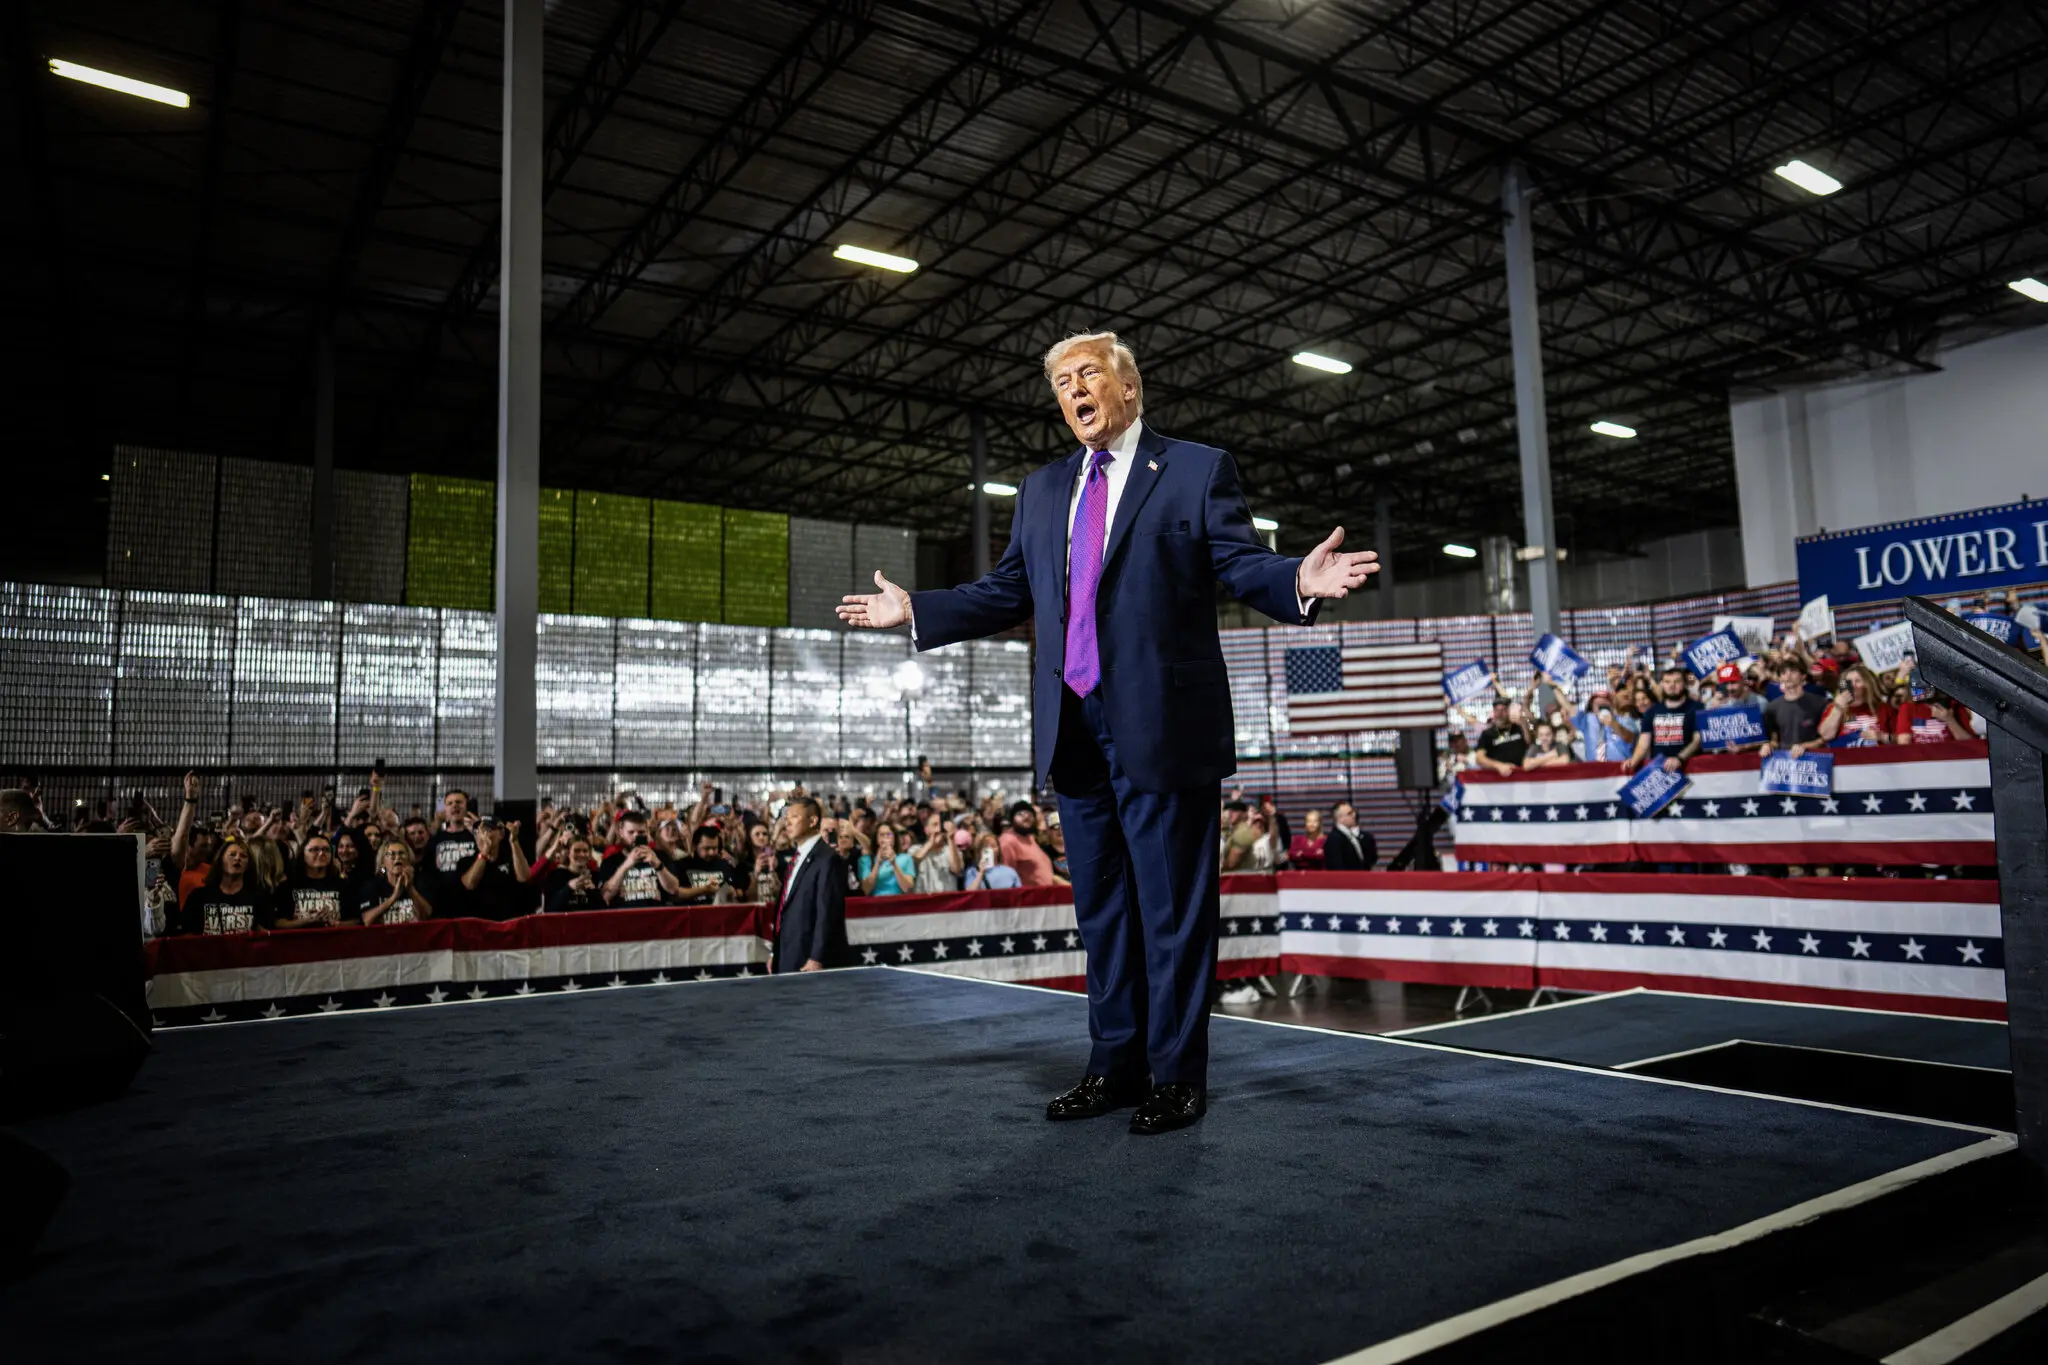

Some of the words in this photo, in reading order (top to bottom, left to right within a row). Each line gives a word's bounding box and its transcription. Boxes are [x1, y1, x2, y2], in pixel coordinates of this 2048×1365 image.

[1855, 527, 2025, 590] LOWER
[1653, 715, 1685, 726] MAKE
[1707, 712, 1749, 729] BIGGER
[1701, 722, 1762, 743] PAYCHECKS
[1772, 759, 1818, 774] BIGGER
